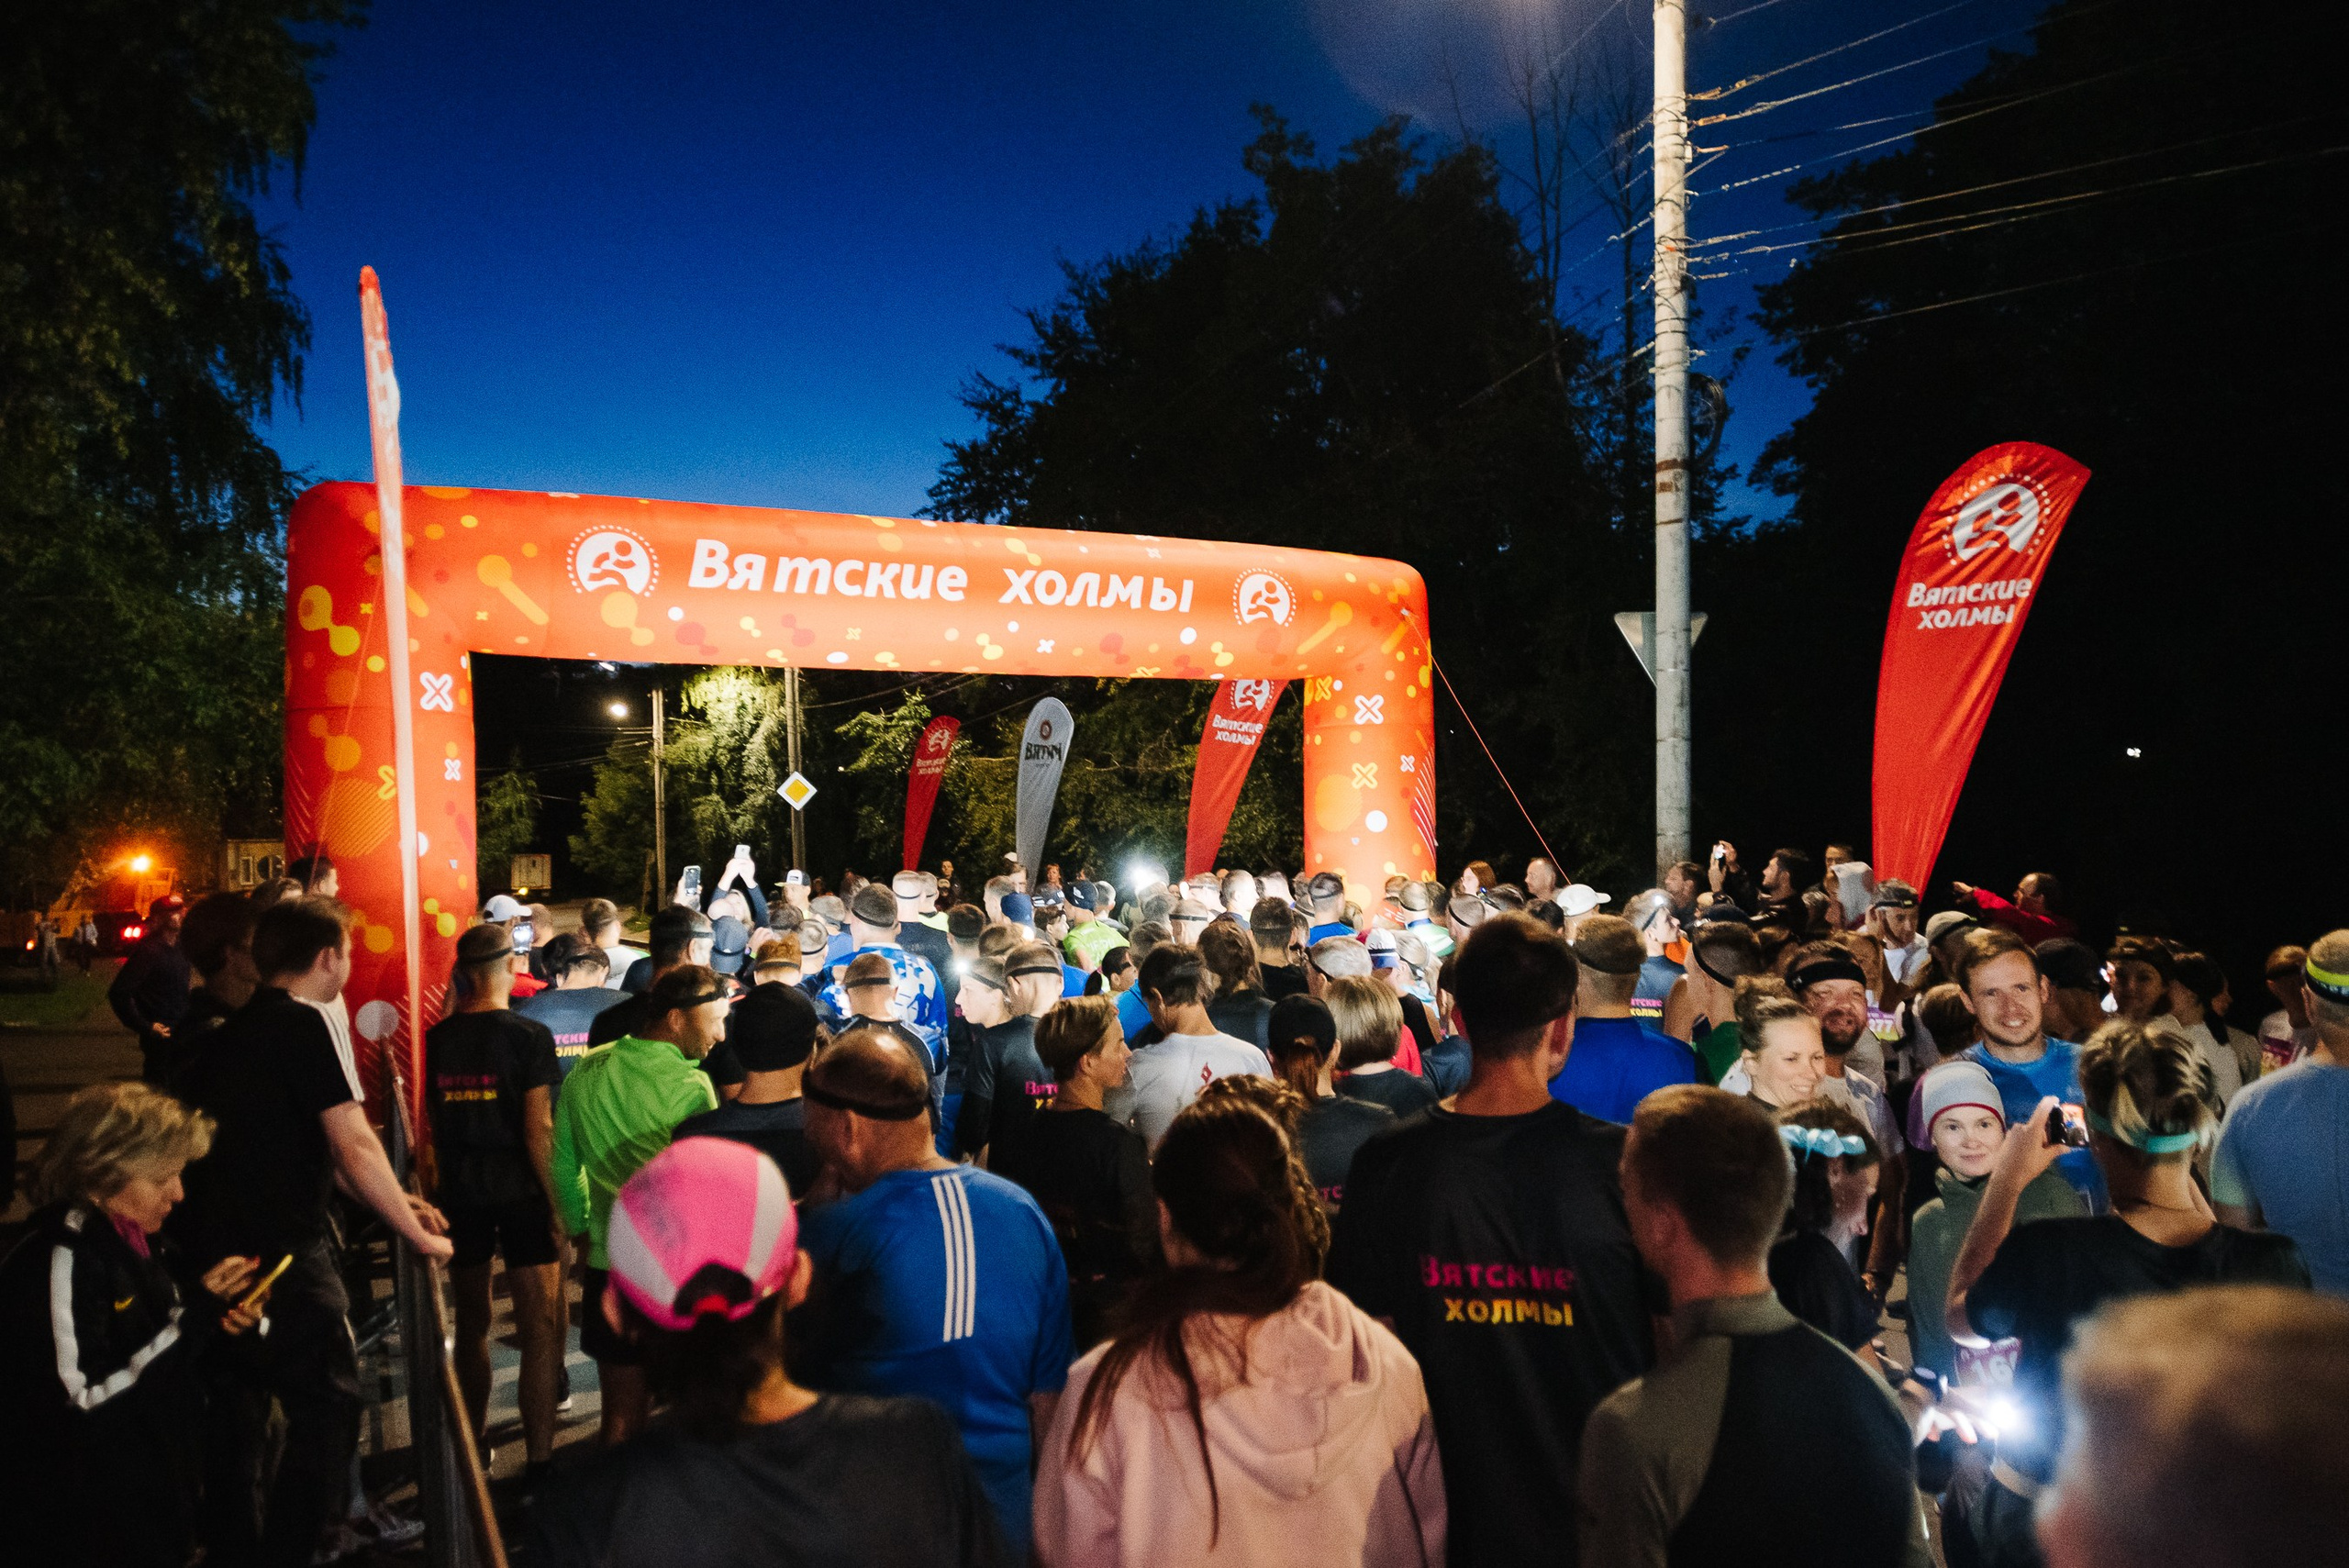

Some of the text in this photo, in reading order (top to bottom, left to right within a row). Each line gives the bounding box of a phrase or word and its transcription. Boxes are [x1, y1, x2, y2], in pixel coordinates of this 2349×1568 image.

[688, 539, 1194, 613] Вятские холмы
[1907, 578, 2032, 607] Вятские
[1917, 604, 2016, 629] холмы
[1212, 714, 1264, 734] Вятские
[1215, 730, 1257, 745] холмы
[1420, 1254, 1575, 1291] Вятские
[1444, 1297, 1574, 1327] холмы
